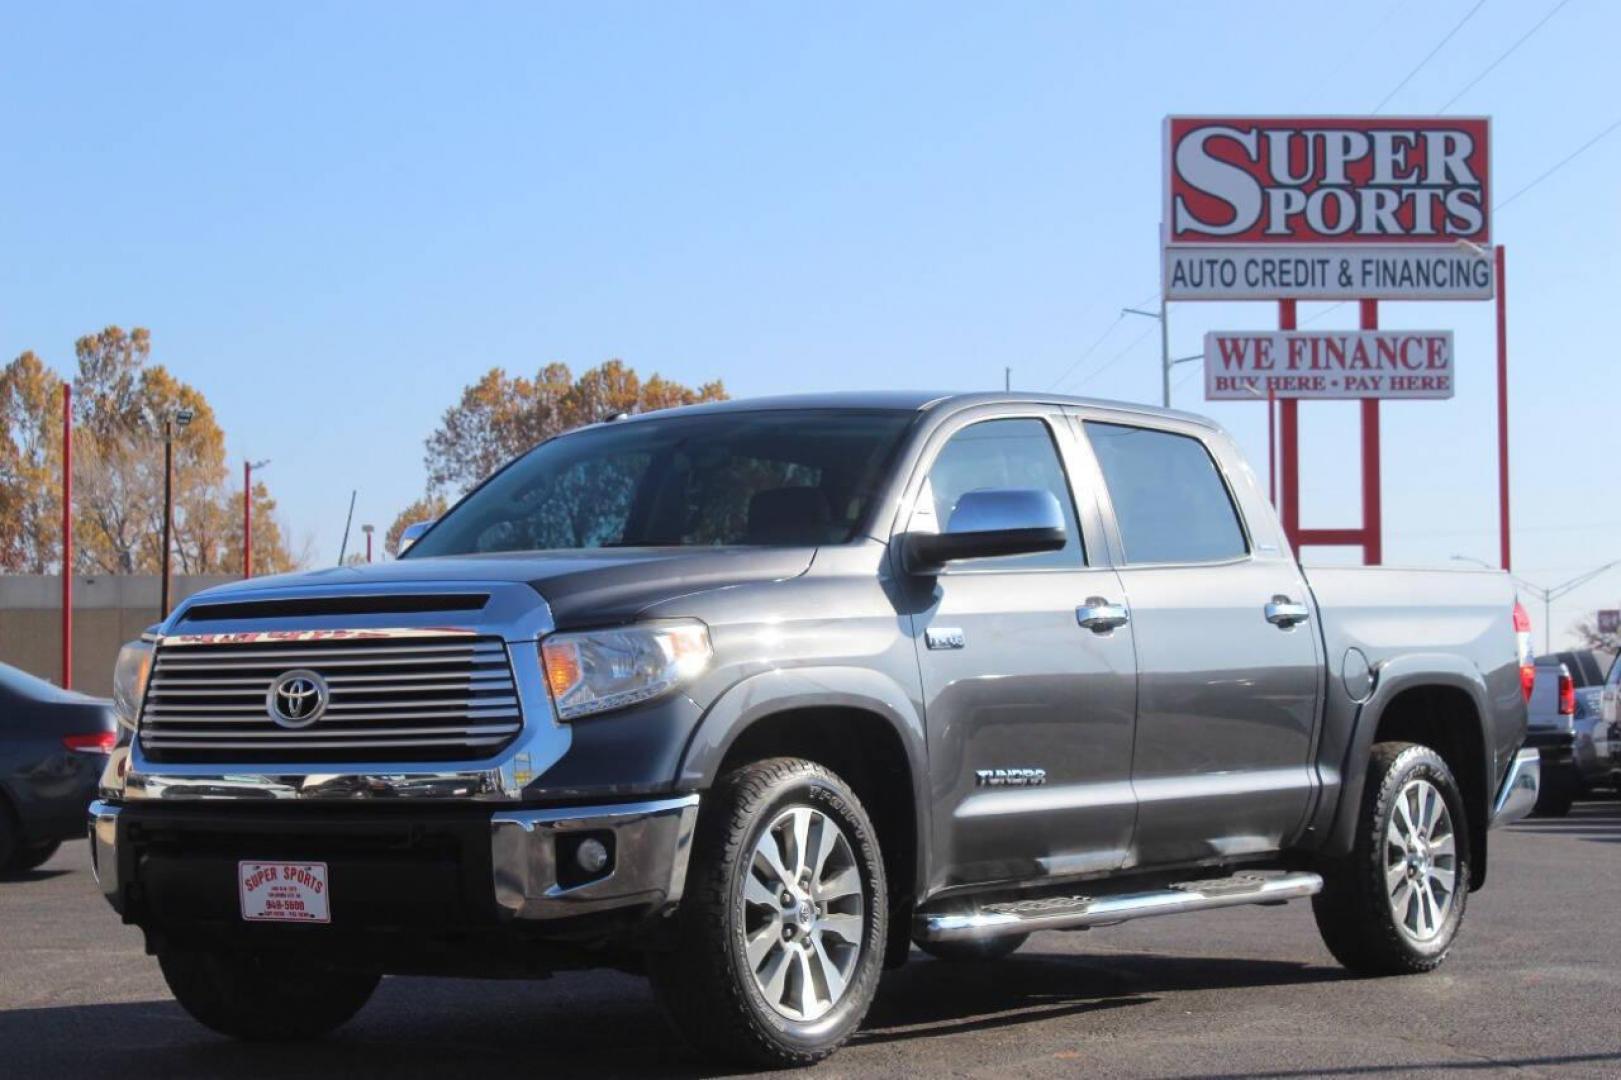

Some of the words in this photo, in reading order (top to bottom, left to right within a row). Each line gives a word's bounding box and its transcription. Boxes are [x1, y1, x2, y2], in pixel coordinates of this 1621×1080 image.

[1174, 125, 1480, 236] SUPER
[1171, 258, 1237, 289] AUTO
[1244, 258, 1330, 289] CREDIT
[1337, 258, 1354, 289] &
[1361, 259, 1490, 290] FINANCING
[1216, 336, 1276, 371] WE
[1286, 336, 1449, 371] FINANCE
[1215, 375, 1260, 392] BUY
[1266, 375, 1326, 392] HERE
[1343, 375, 1384, 392] PAY
[1389, 375, 1450, 392] HERE
[975, 768, 1047, 786] TUNDRA
[244, 867, 277, 892] SUPER
[283, 866, 323, 894] SPORTS
